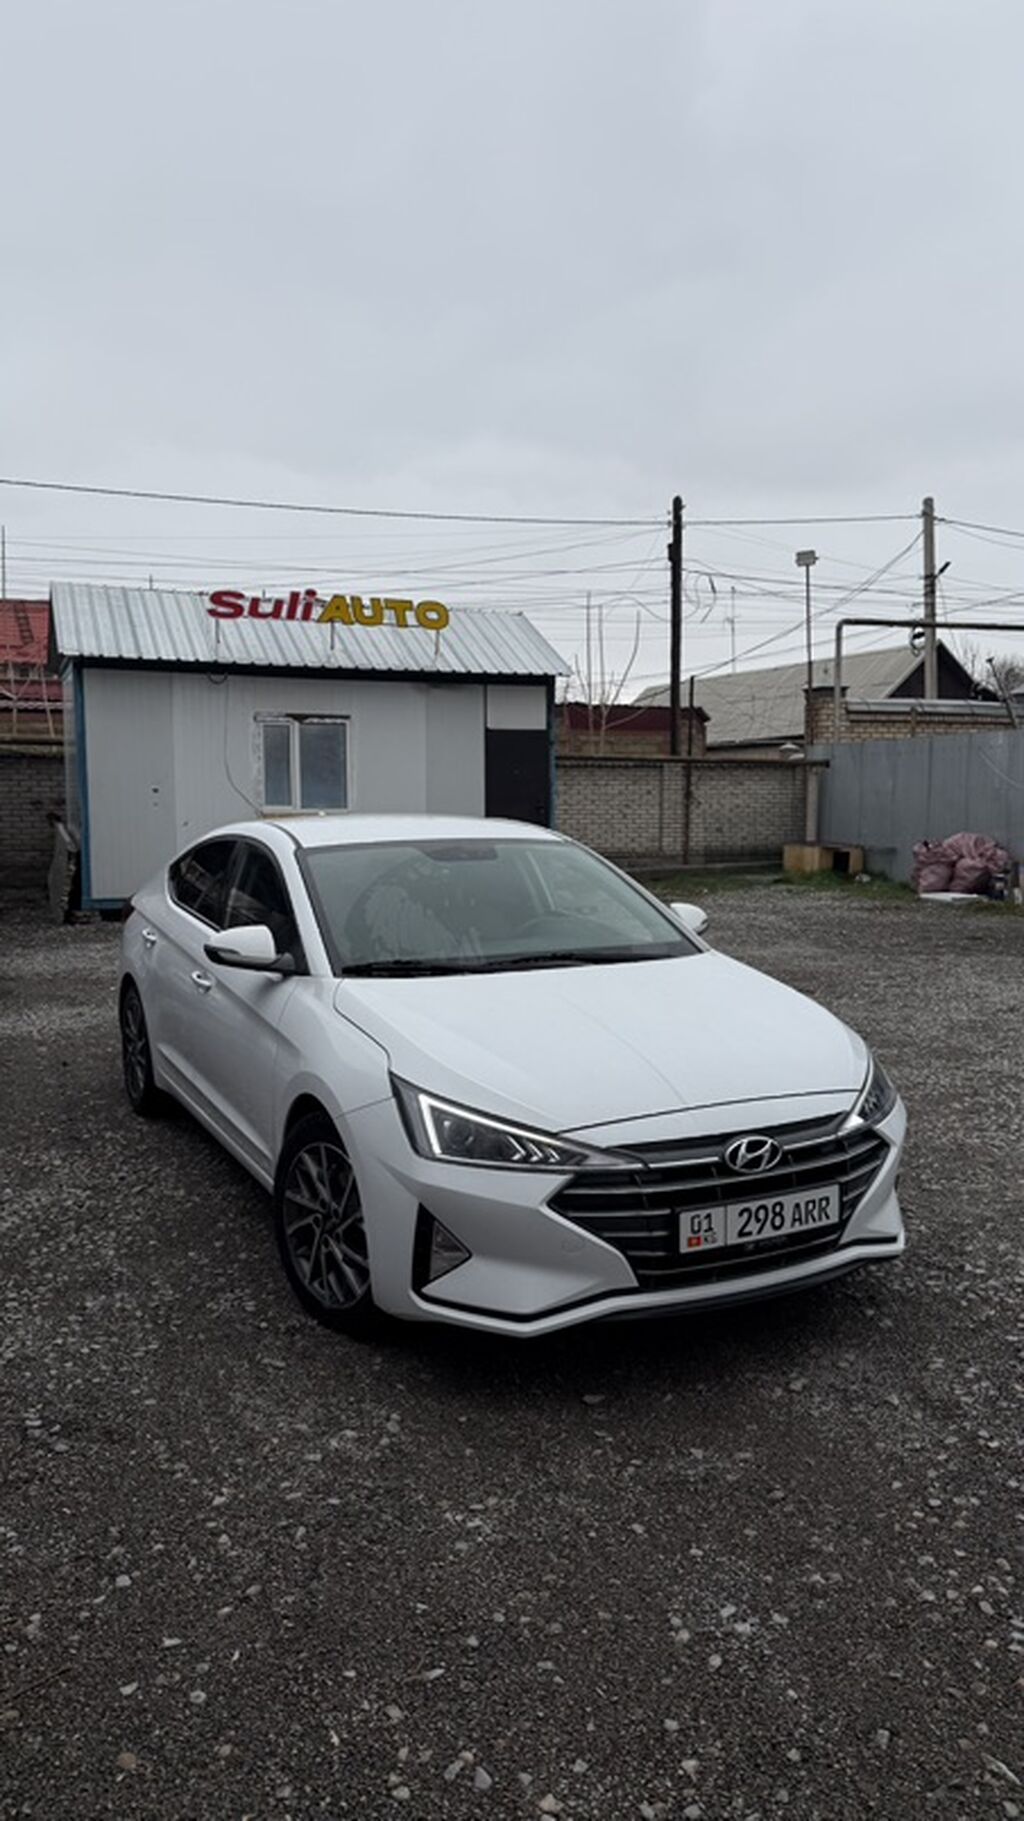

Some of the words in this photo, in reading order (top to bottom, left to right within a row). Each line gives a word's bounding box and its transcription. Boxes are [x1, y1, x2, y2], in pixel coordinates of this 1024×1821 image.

[690, 1213, 714, 1235] 01
[737, 1201, 785, 1238] 298
[790, 1196, 830, 1228] ARR
